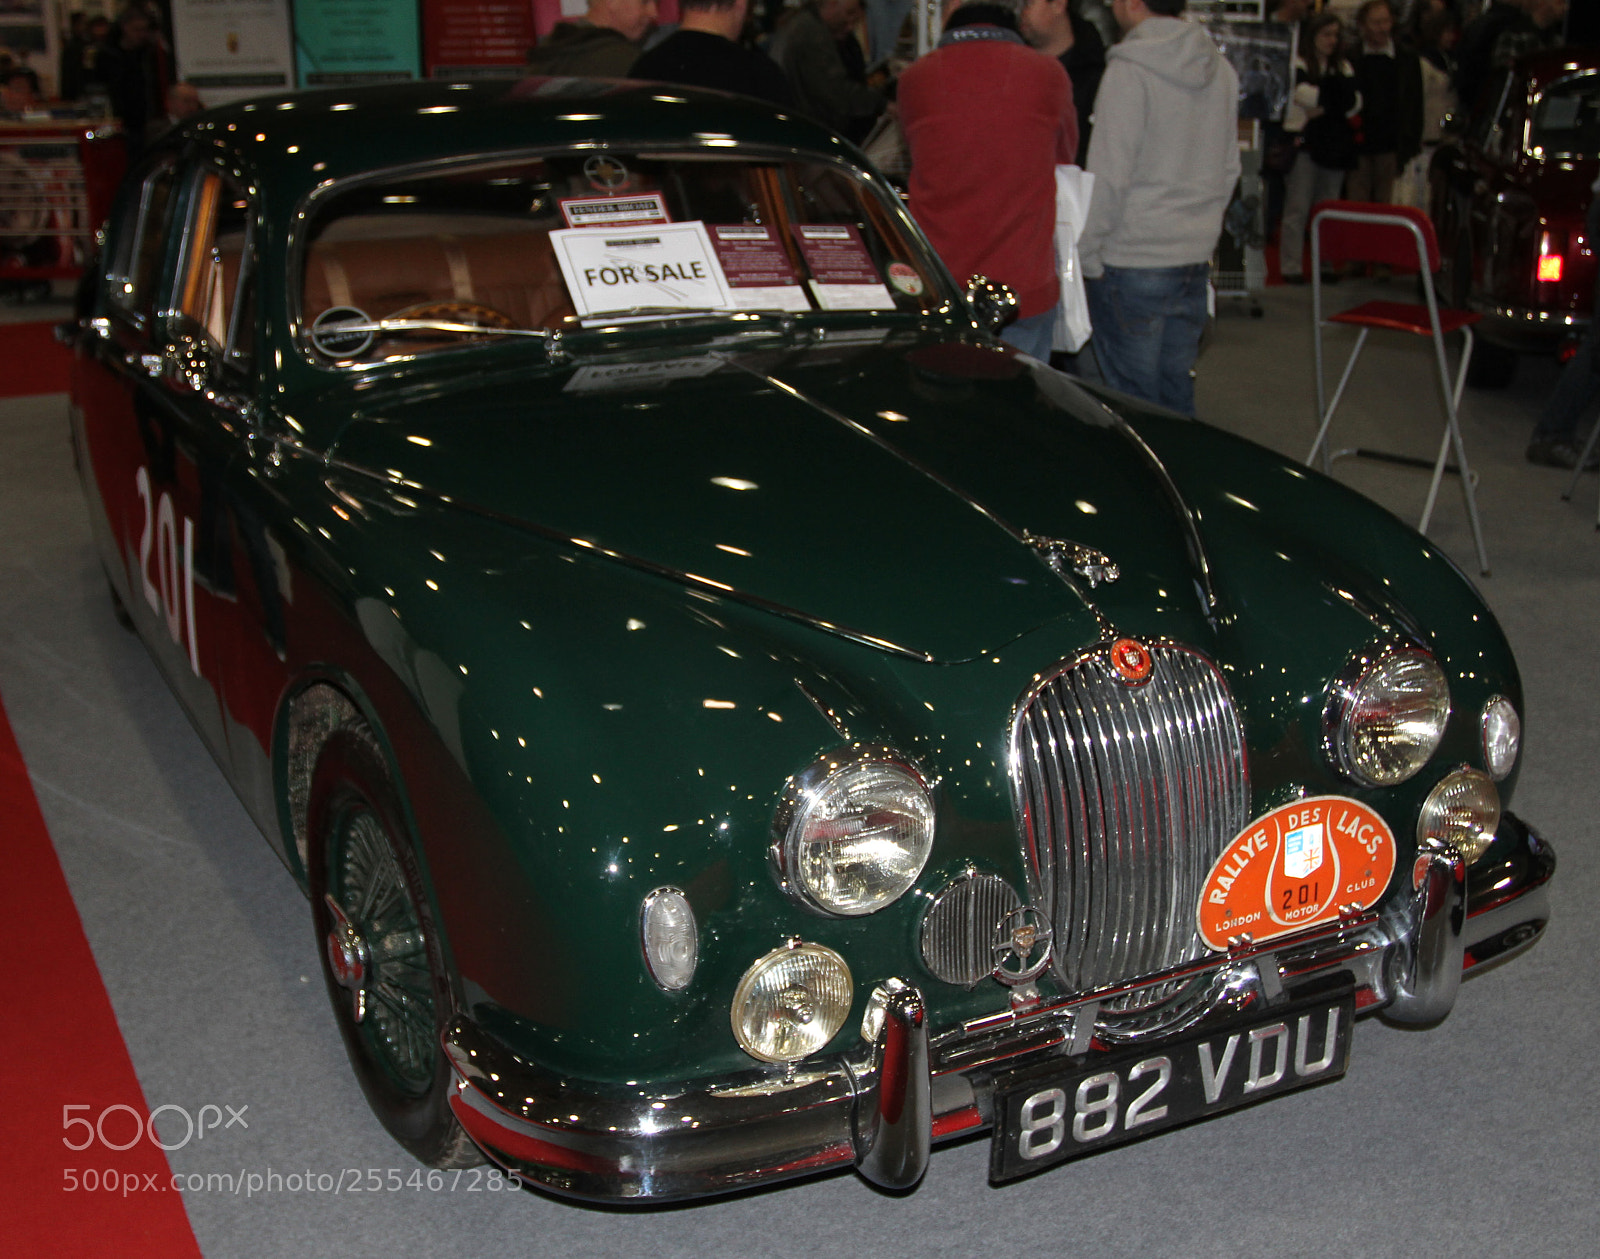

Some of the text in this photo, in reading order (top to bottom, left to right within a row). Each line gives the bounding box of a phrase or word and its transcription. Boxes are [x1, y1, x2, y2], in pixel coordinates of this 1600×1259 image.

[584, 261, 706, 287] FOR SALE
[136, 465, 200, 677] 201
[1208, 828, 1269, 905] RALLYE
[1288, 807, 1321, 829] DES
[1215, 878, 1375, 932] LONDON MOTOR CLUB
[1282, 882, 1319, 910] 201
[1019, 1007, 1340, 1160] 882 VDU
